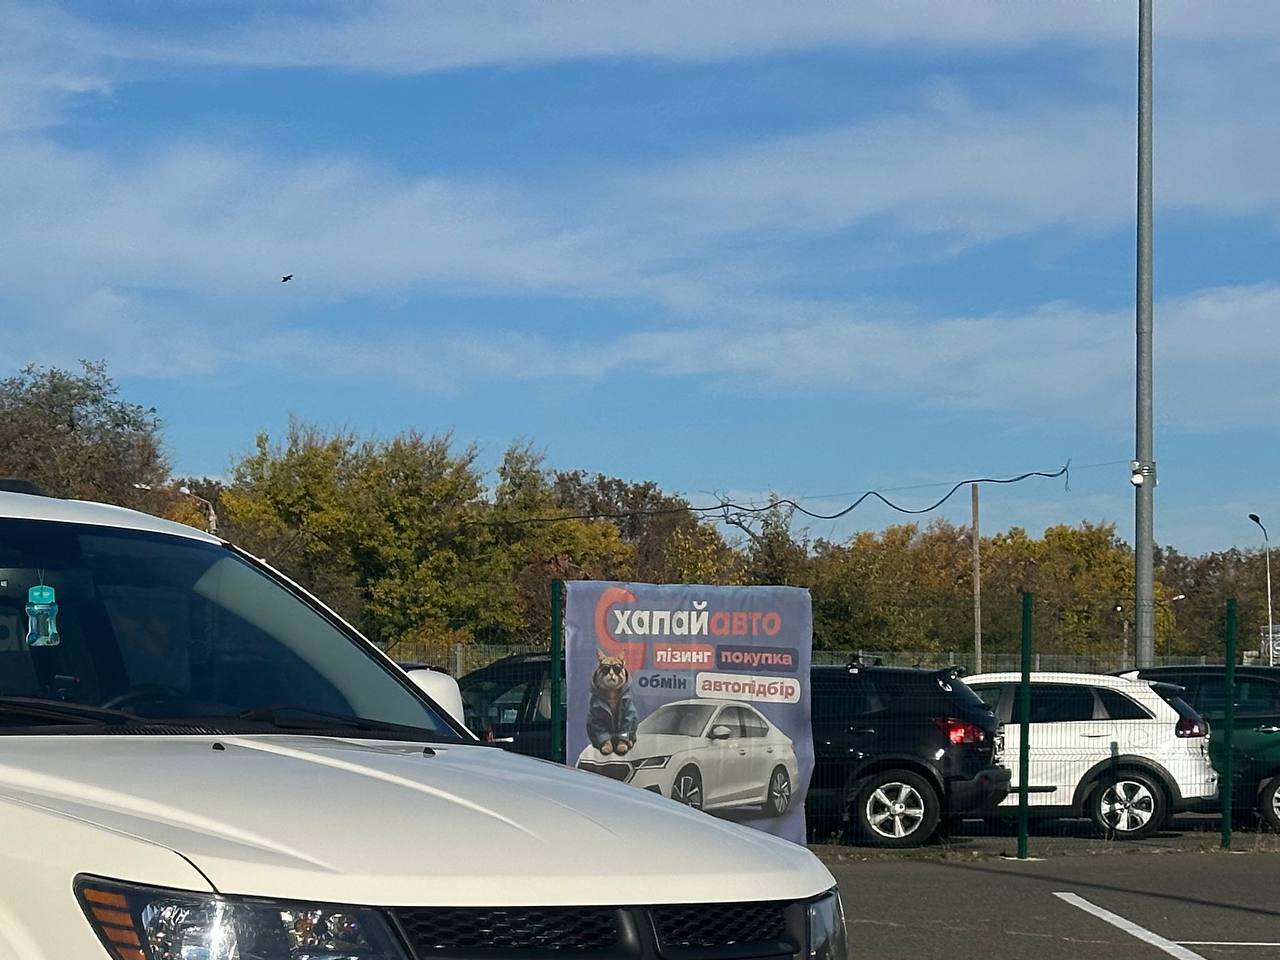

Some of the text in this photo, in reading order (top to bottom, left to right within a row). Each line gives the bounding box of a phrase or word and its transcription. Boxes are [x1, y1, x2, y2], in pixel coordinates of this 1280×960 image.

[656, 648, 793, 669] лізинг покупка
[638, 673, 795, 699] обмін автопідбір
